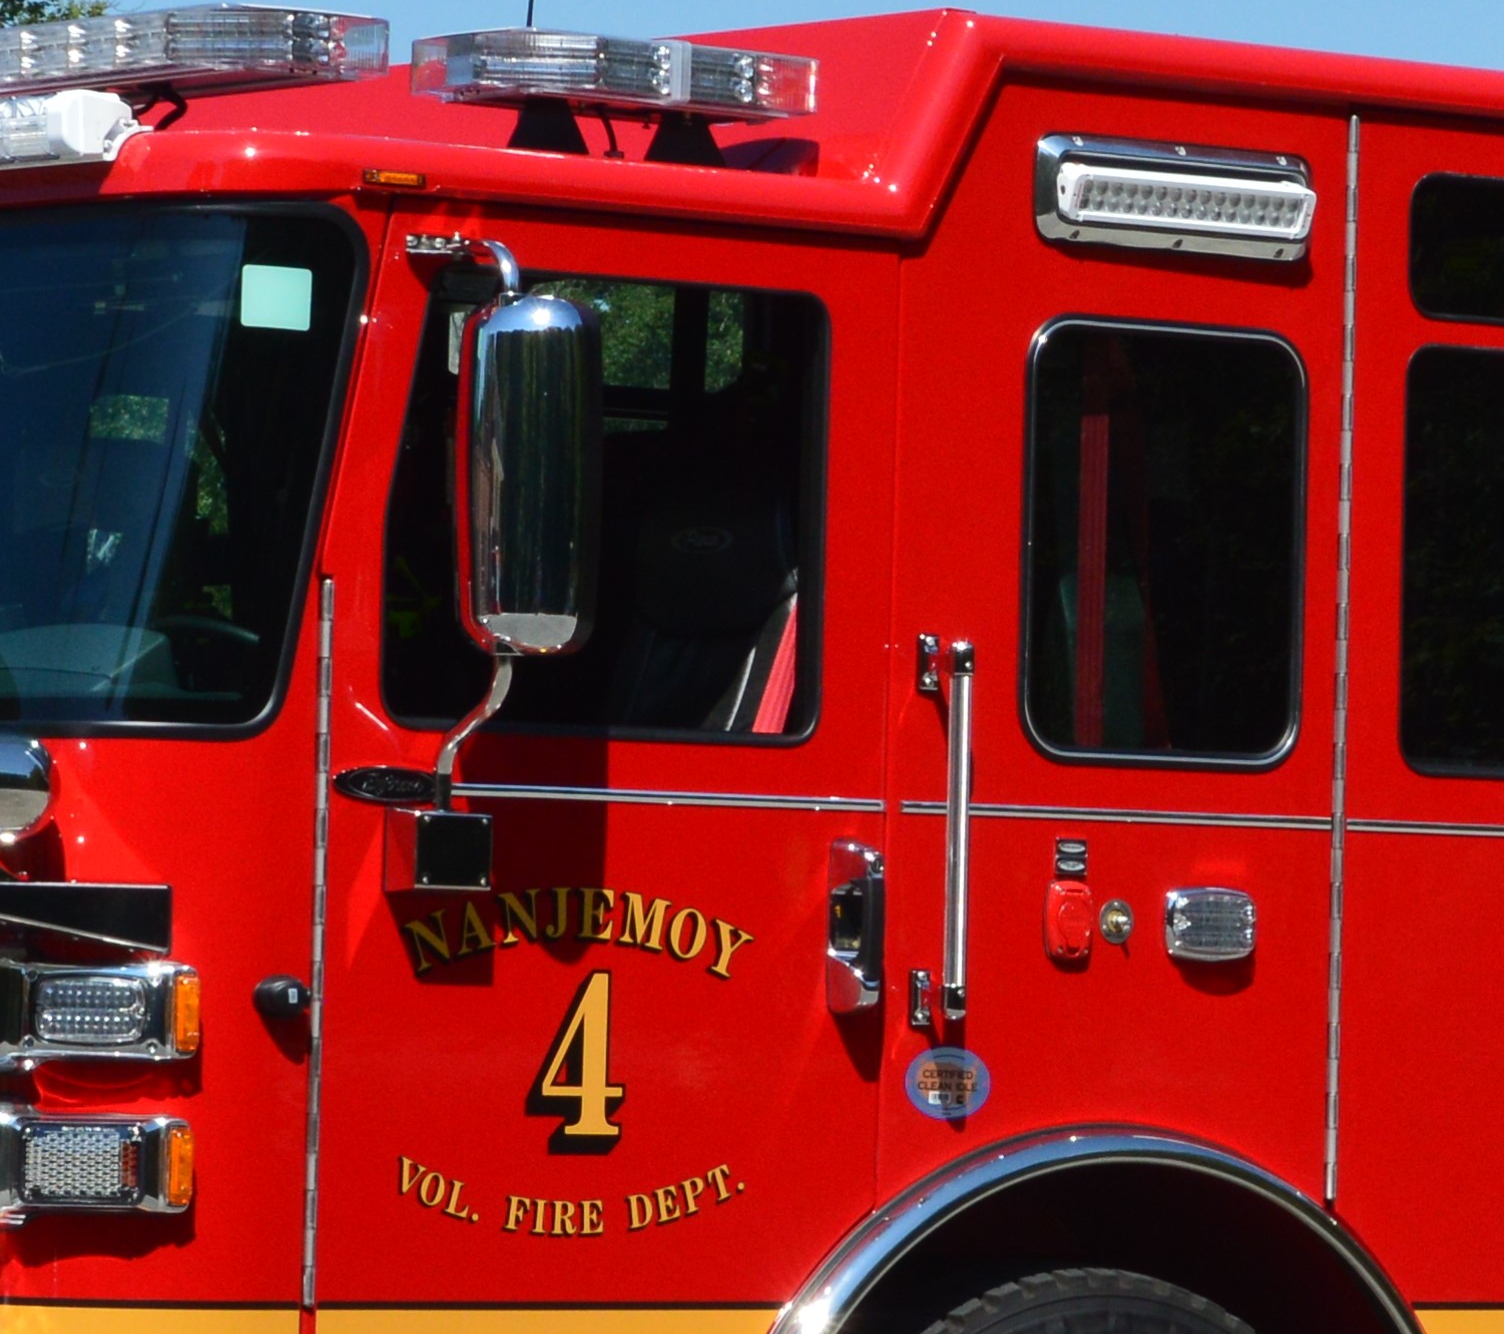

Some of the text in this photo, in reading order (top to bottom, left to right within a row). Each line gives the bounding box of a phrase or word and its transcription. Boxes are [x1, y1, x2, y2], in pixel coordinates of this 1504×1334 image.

[404, 886, 755, 979] NANJEMOY
[534, 971, 624, 1147] 4
[917, 1081, 977, 1092] CLEAN IDLE
[922, 1069, 974, 1080] CERTIFIED
[397, 1154, 746, 1236] VOL. FIRE DEPT.
